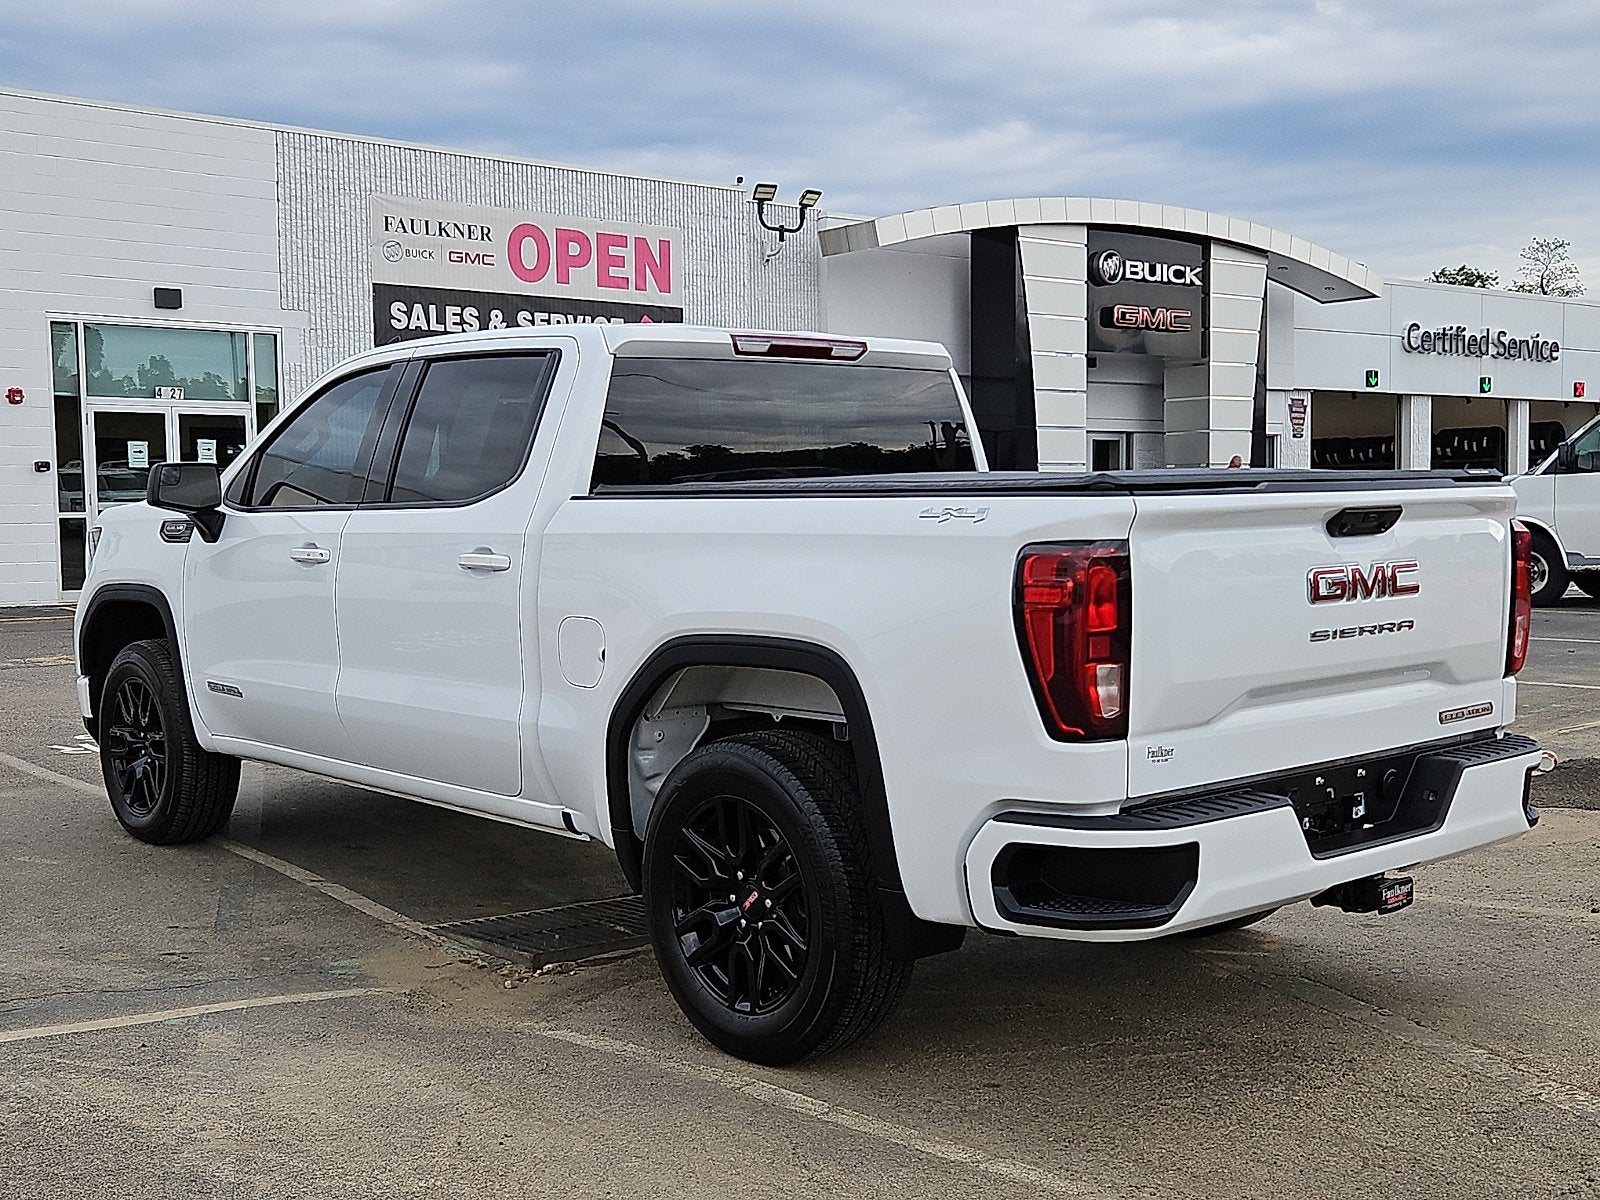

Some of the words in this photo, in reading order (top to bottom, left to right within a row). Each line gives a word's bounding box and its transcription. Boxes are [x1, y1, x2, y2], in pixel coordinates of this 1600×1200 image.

[383, 215, 493, 242] FAULKNER
[405, 248, 434, 260] BUICK
[448, 251, 495, 266] GMC
[507, 222, 672, 295] OPEN
[1125, 259, 1203, 286] BUICK
[390, 301, 480, 332] SALES
[489, 309, 508, 330] &
[1113, 304, 1191, 331] GMC
[1405, 322, 1490, 356] Certified
[1496, 330, 1560, 362] Service
[1308, 559, 1421, 605] GMC
[1309, 618, 1415, 643] SIERRA
[1382, 883, 1413, 901] Faulkner
